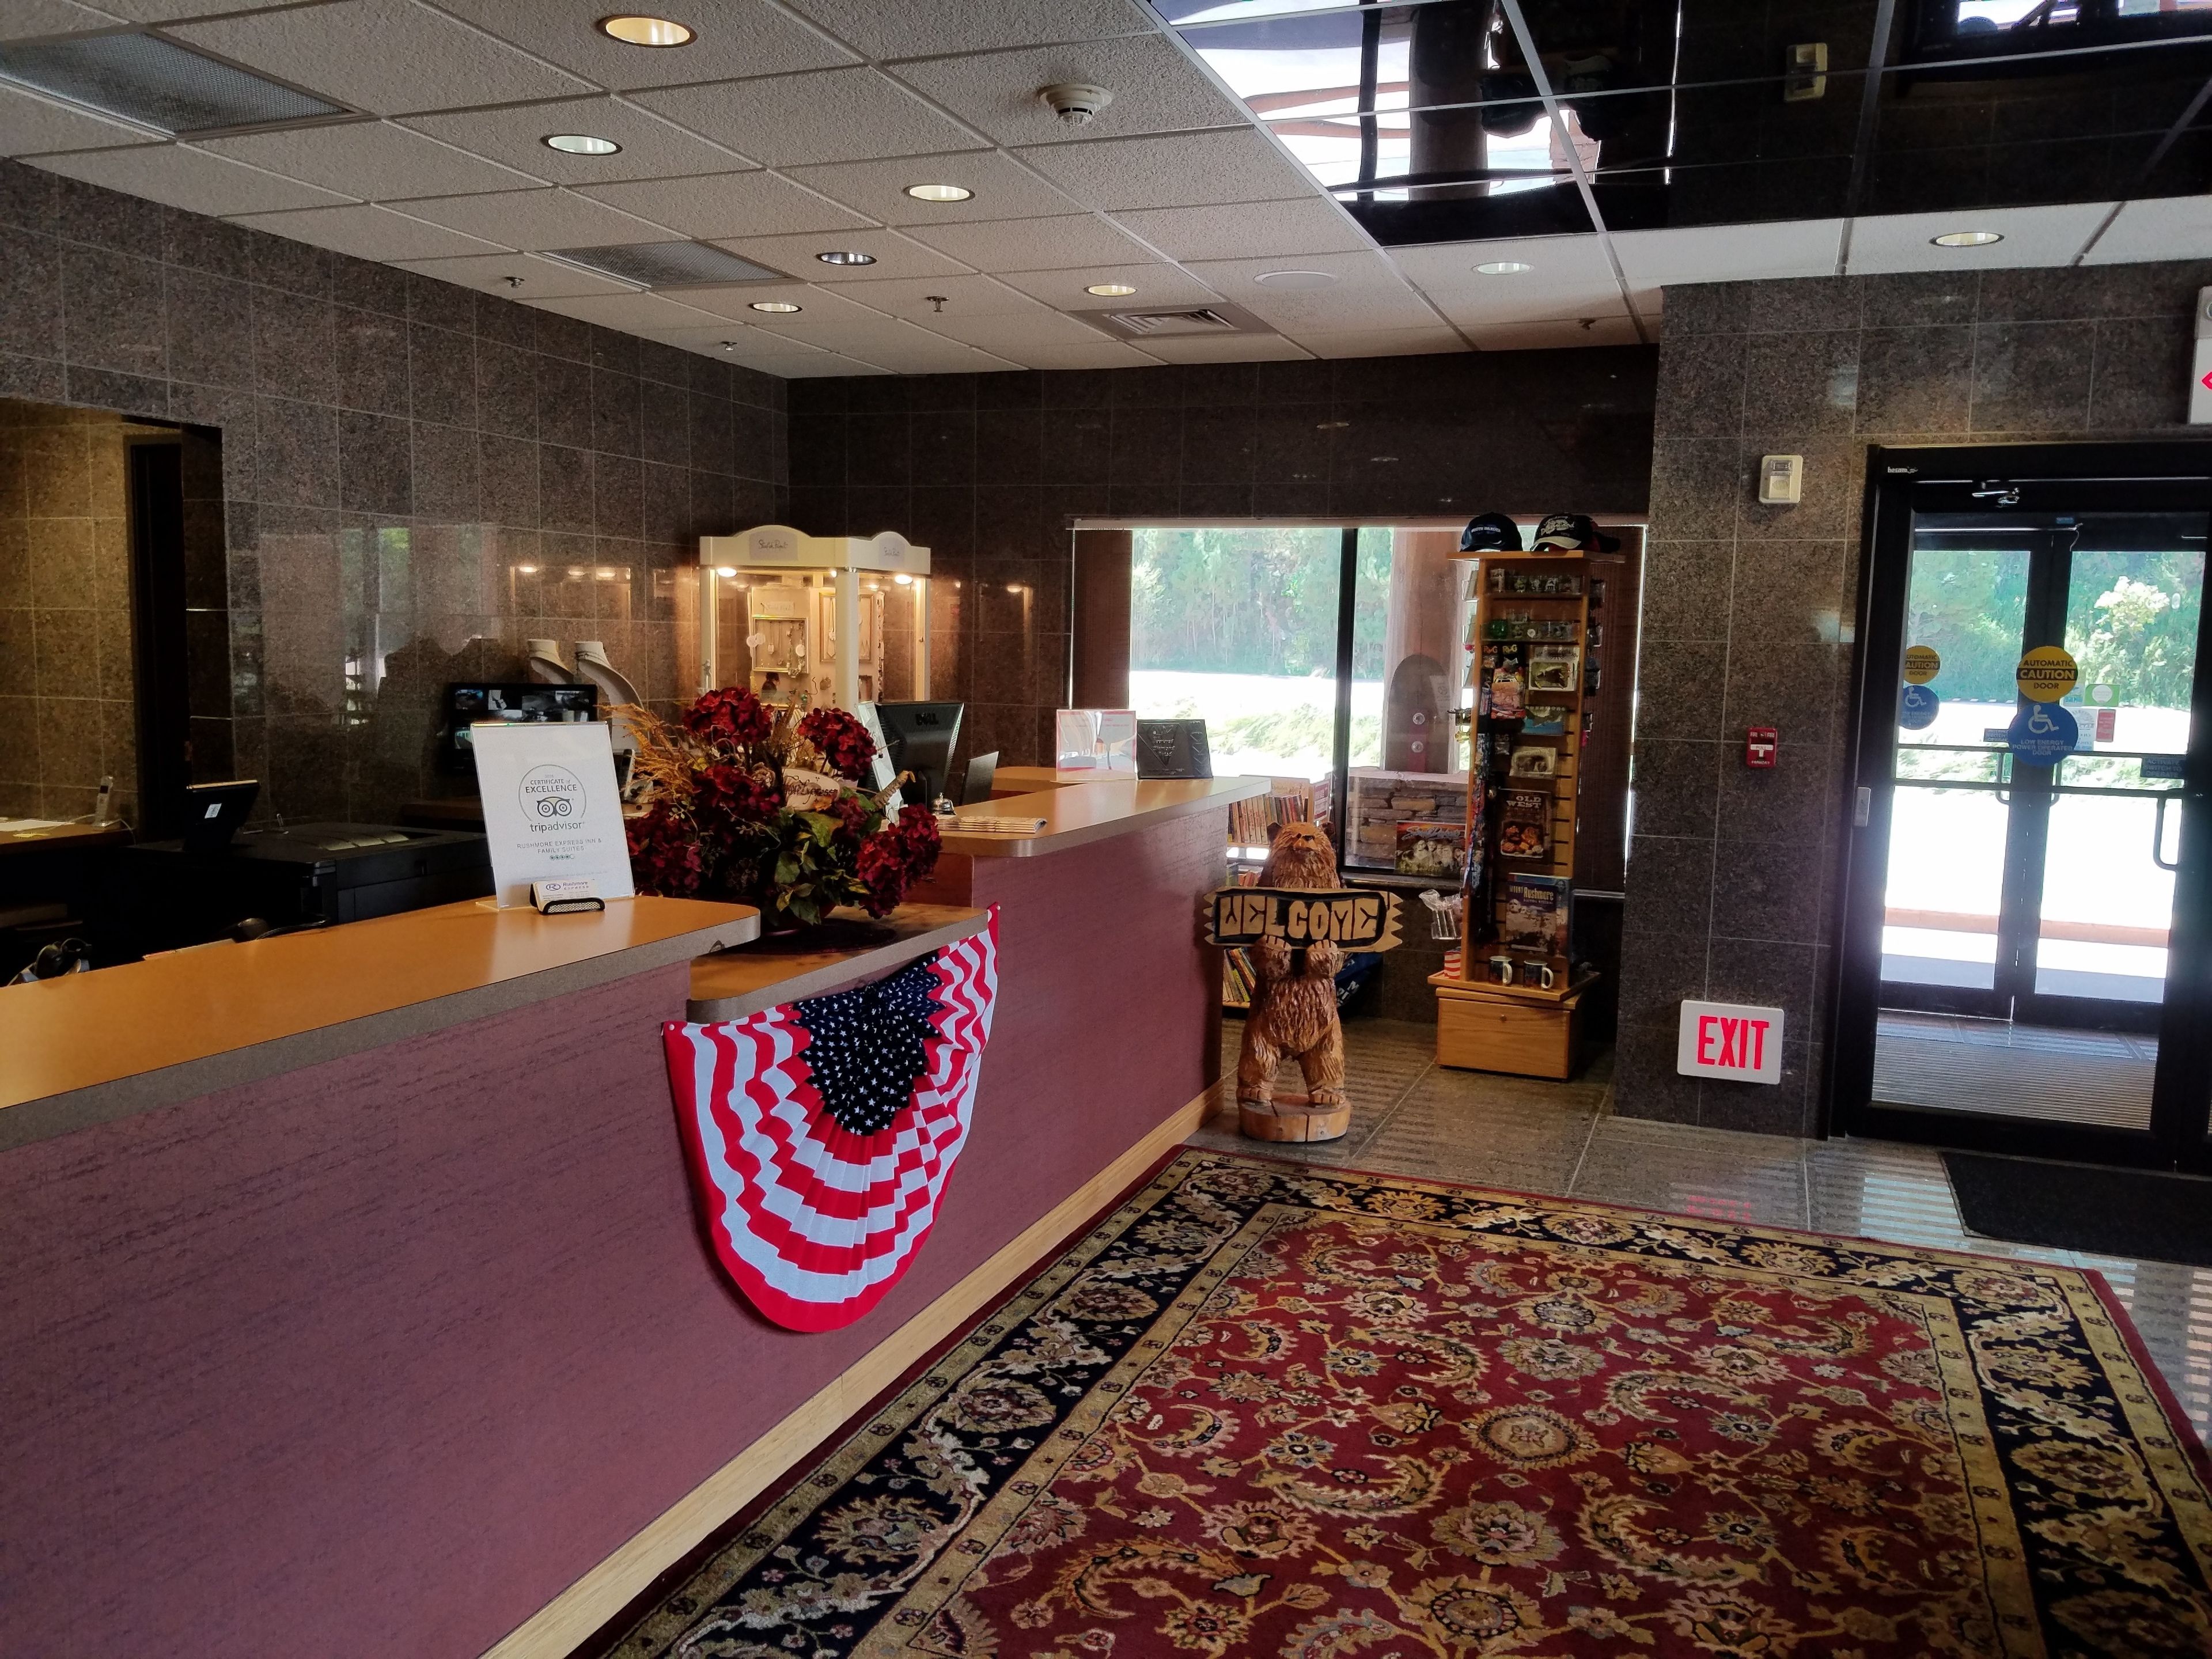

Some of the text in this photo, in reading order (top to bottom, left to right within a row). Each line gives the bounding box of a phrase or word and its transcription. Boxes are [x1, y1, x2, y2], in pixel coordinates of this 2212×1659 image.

[2020, 669, 2075, 679] CAUTION
[525, 784, 578, 793] EXCELLENCE
[1506, 800, 1542, 809] WEST
[529, 821, 582, 834] tripadvisor
[1219, 894, 1380, 941] WELCOME
[1697, 1015, 1770, 1070] EXIT
